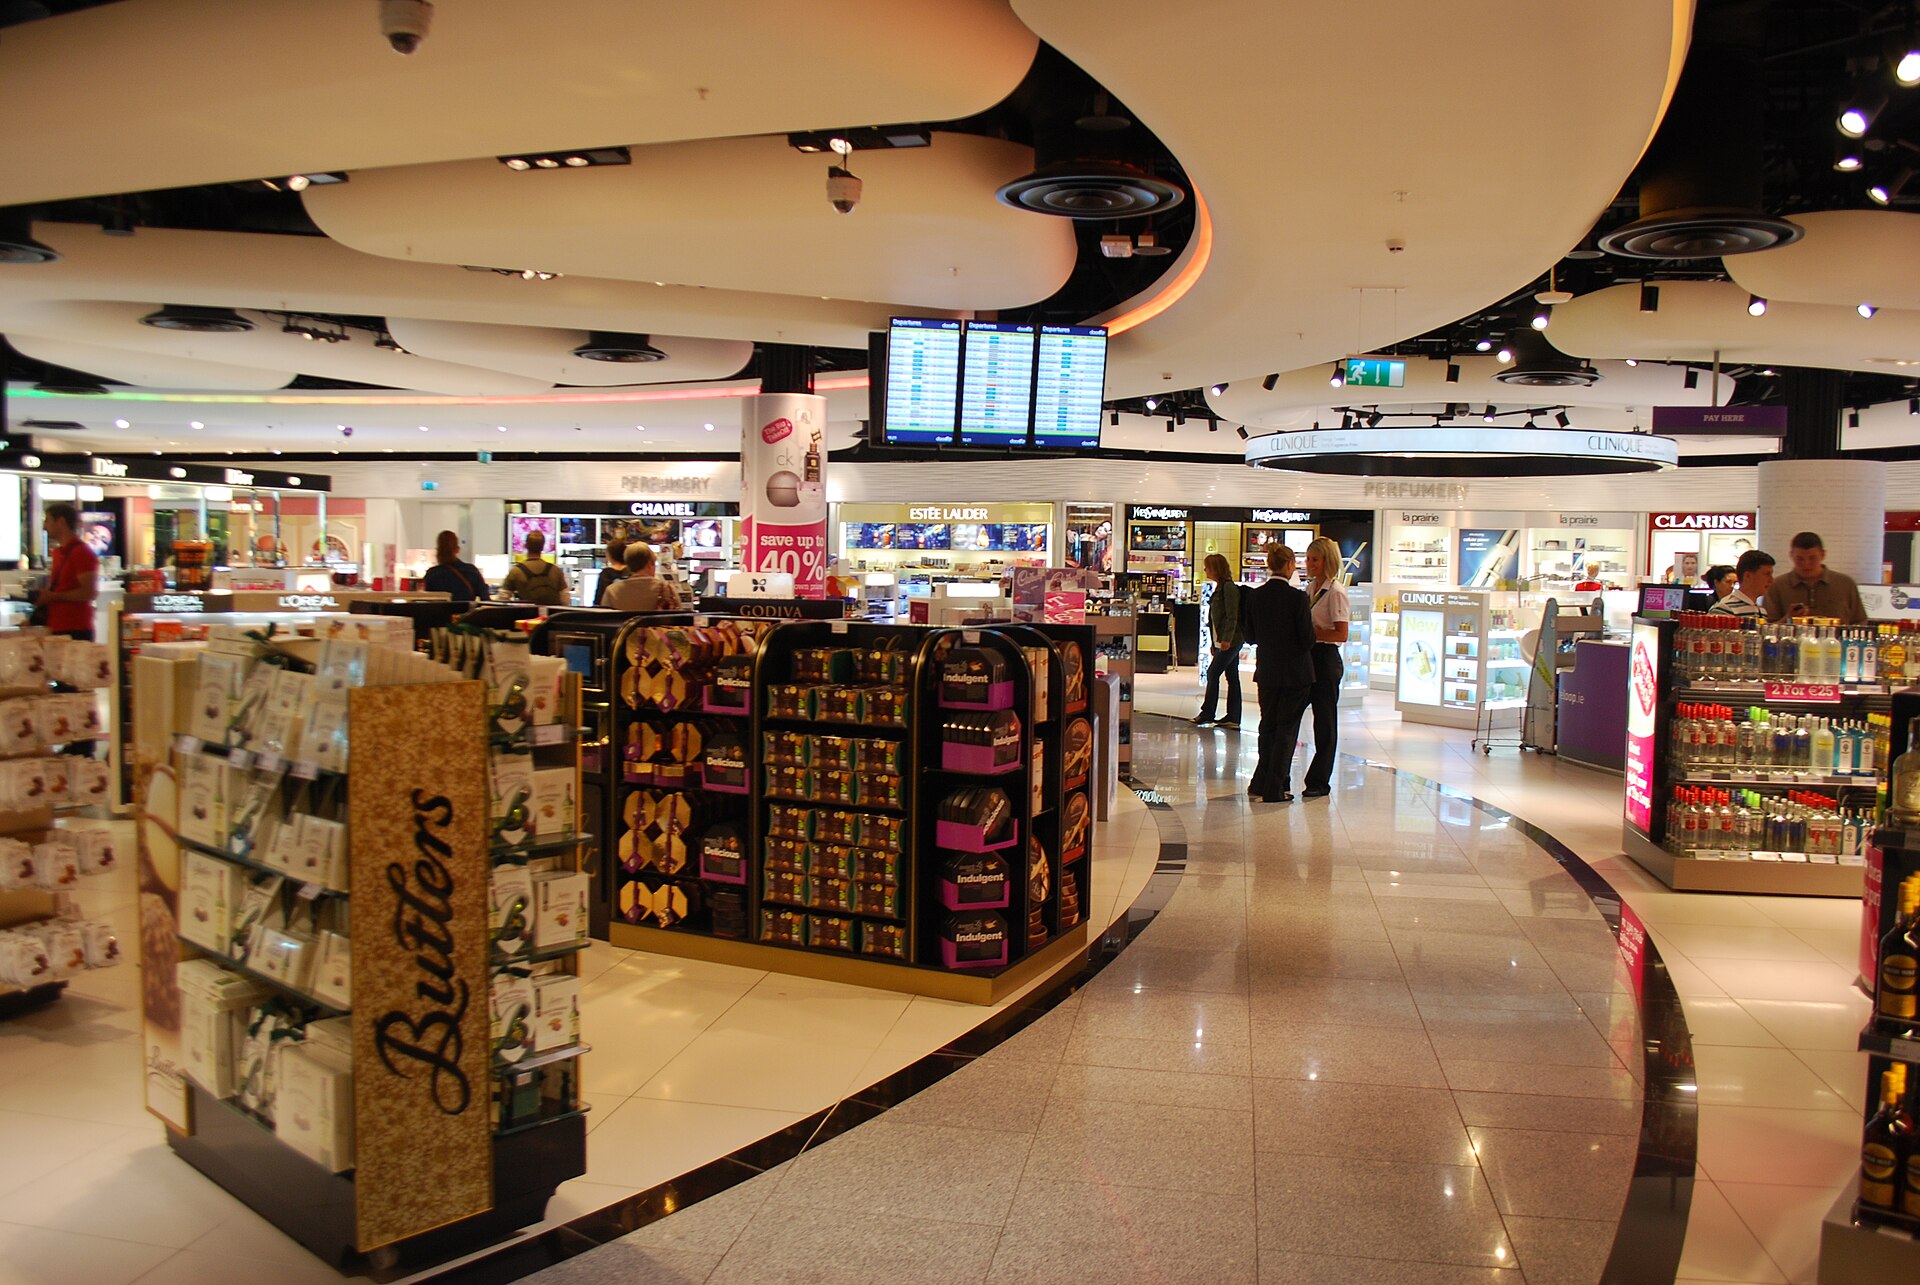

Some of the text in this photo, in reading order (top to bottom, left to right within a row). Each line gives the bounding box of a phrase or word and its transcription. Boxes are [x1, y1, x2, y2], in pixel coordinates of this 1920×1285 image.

[892, 318, 922, 327] Departures
[968, 322, 998, 330] Departures
[1042, 325, 1071, 334] Departures
[1703, 414, 1745, 422] PAY HERE
[1270, 434, 1319, 451] CLINIQUE
[1587, 435, 1643, 454] CLINIQUE
[776, 447, 794, 466] ck
[92, 457, 129, 477] Dior
[621, 475, 711, 492] PERFUMERY
[1364, 482, 1470, 500] PERFUMERY
[630, 502, 696, 516] CHANEL
[909, 507, 989, 520] ESTÉE LAUDER
[1402, 512, 1439, 524] la prairie
[1559, 514, 1598, 526] la prairie
[1654, 514, 1749, 529] CLARINS
[760, 535, 794, 546] save
[797, 535, 814, 549] up
[760, 550, 824, 581] 40%
[1401, 592, 1445, 605] CLINIQUE
[740, 604, 803, 618] GODIVA
[1405, 616, 1439, 633] New
[943, 673, 989, 684] Indulgent
[1771, 684, 1834, 697] 2 For €25
[706, 756, 745, 768] Delicious
[704, 846, 740, 859] Delicious
[957, 873, 1004, 884] Indulgent
[956, 931, 1003, 943] Indulgent
[376, 788, 471, 1115] Butlers
